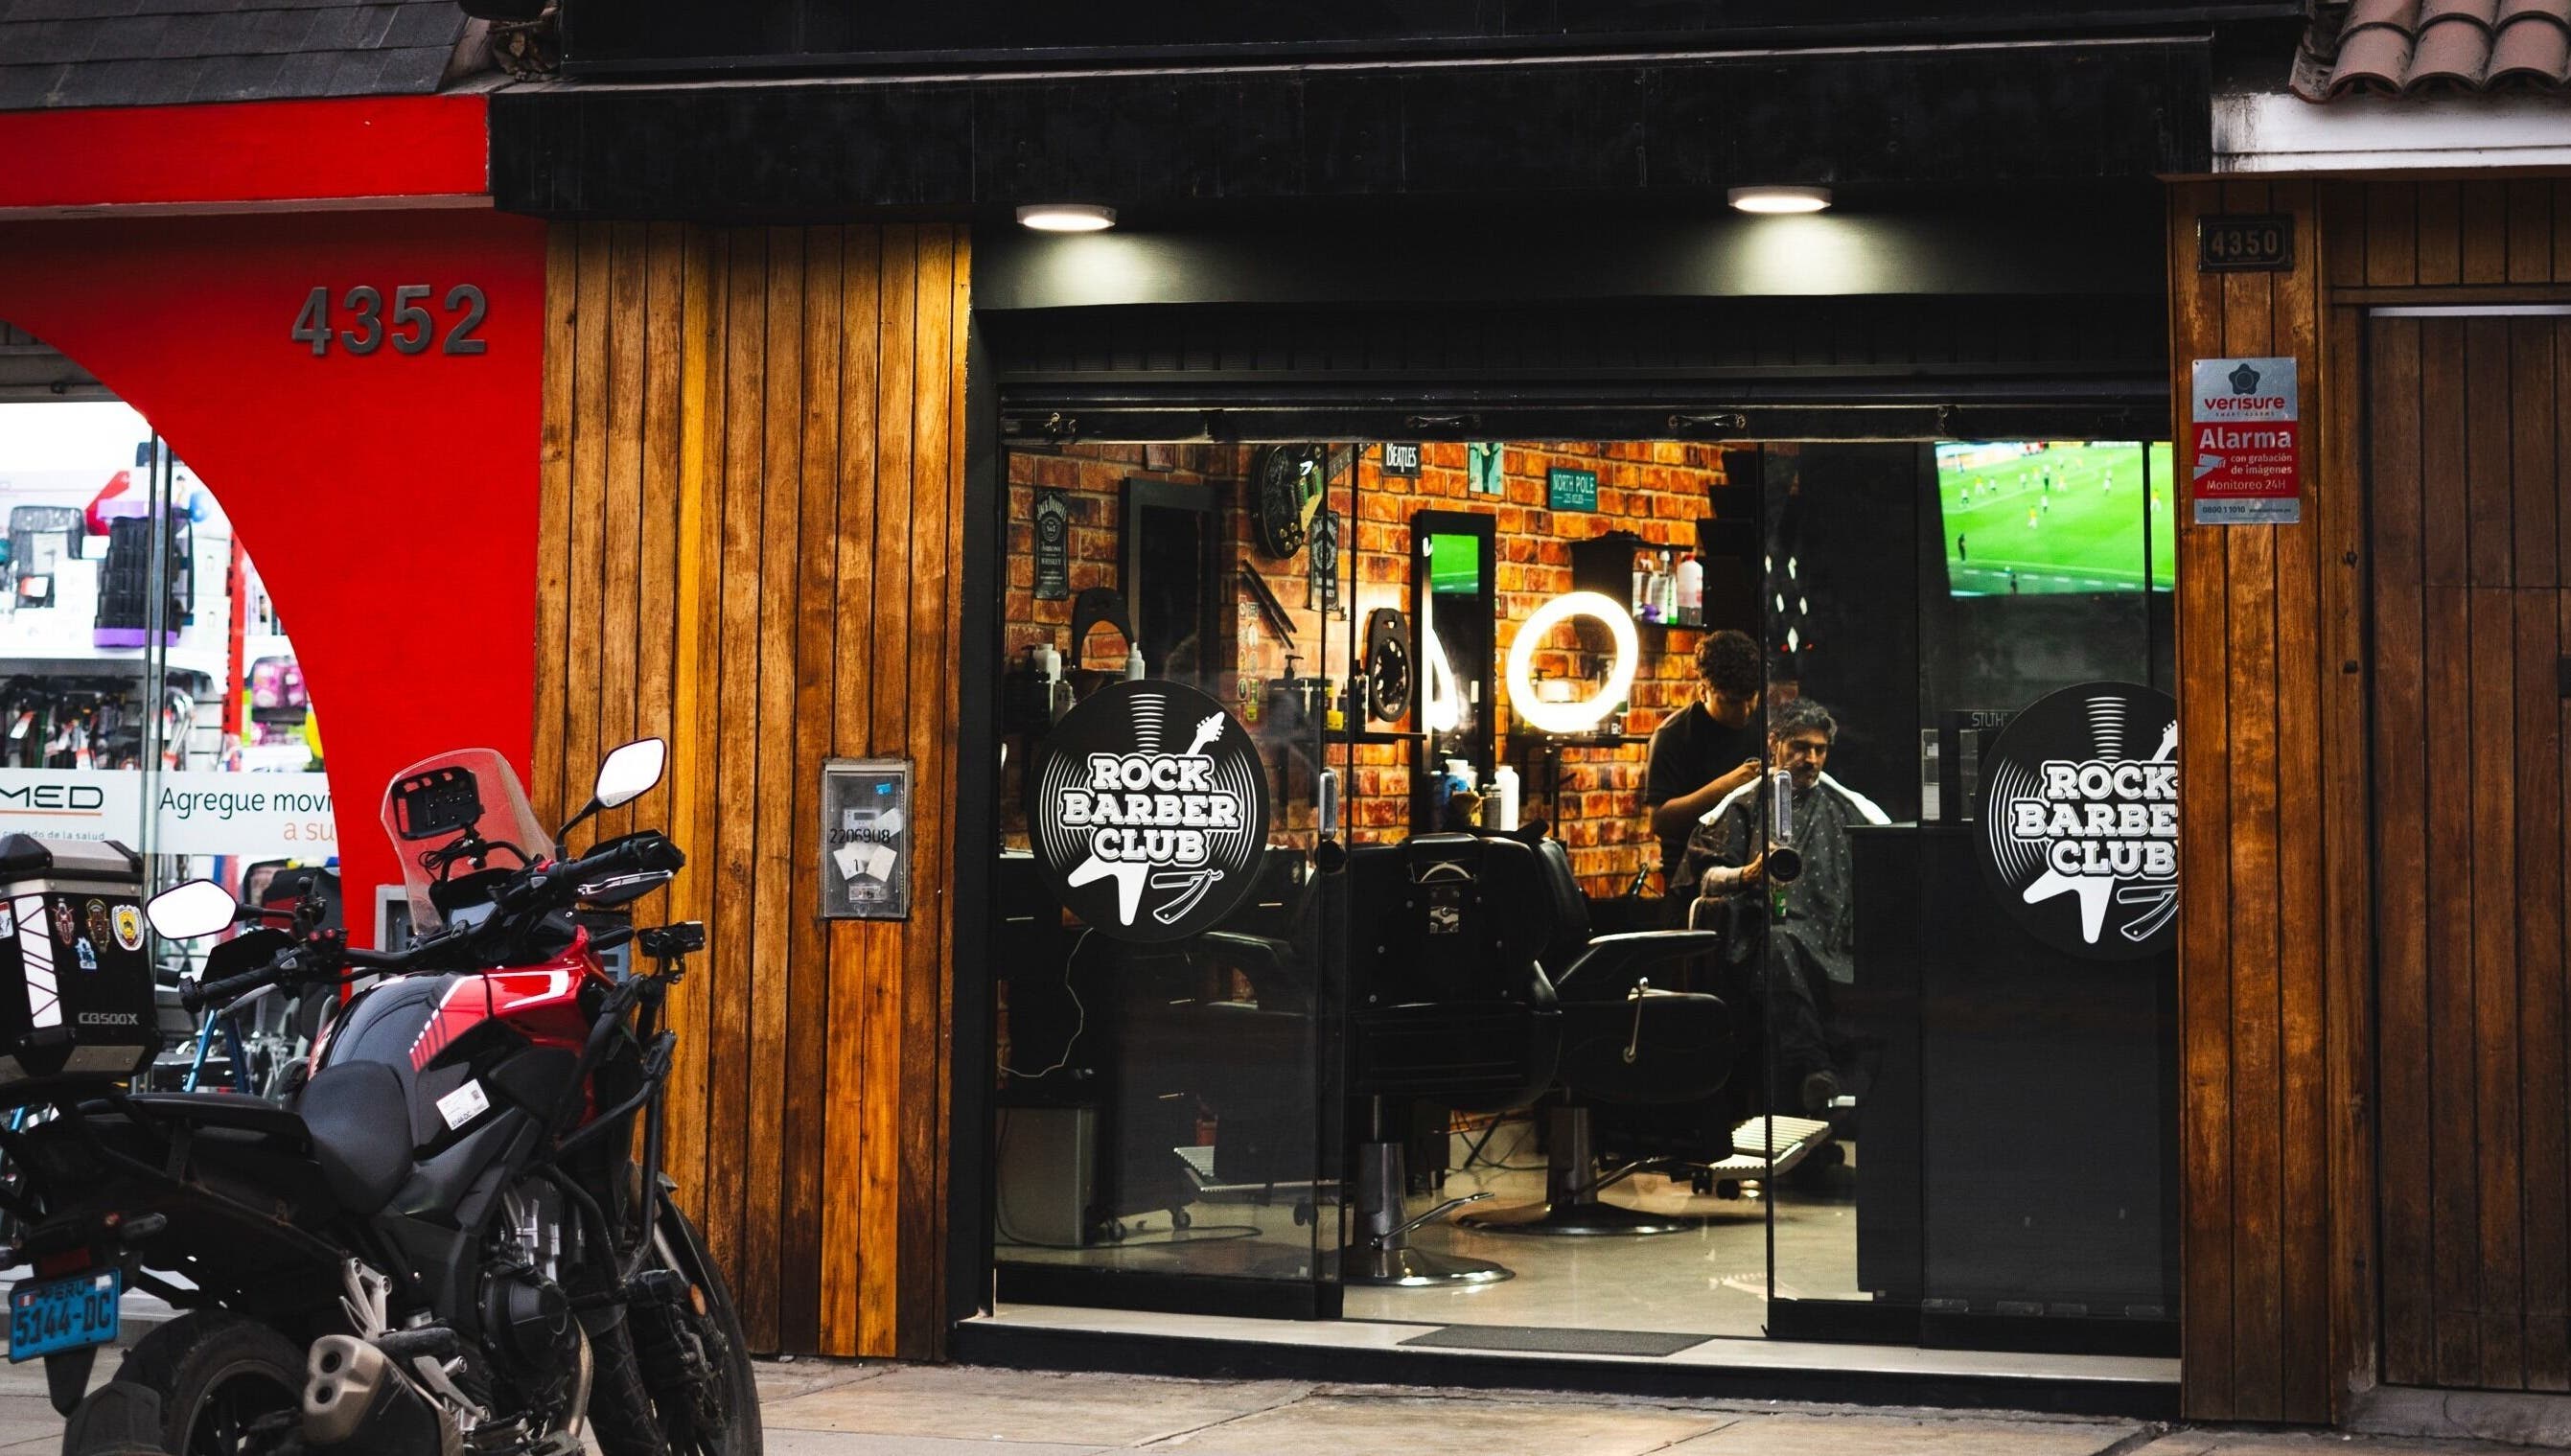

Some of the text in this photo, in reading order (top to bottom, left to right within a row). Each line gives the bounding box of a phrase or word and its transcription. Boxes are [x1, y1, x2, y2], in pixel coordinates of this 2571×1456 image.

[2212, 230, 2278, 257] 4350
[291, 284, 487, 356] 4352
[2205, 397, 2285, 410] verisure
[2199, 427, 2292, 450] Alarma
[1386, 443, 1417, 474] BEATLES
[2231, 465, 2293, 476] de imágenes
[2248, 453, 2293, 465] grabación
[1553, 474, 1595, 495] NORTH POLE
[2207, 479, 2286, 491] Monitoreo 24H
[2202, 505, 2222, 514] 0800
[1092, 757, 1211, 792] ROCK
[2046, 765, 2177, 800] ROCK
[0, 785, 104, 810] MED
[159, 787, 266, 820] Agregue
[1062, 793, 1239, 828] BARBER
[284, 821, 336, 842] a su
[2013, 802, 2177, 838] BARBE
[47, 830, 59, 839] de
[62, 830, 73, 840] la
[76, 831, 104, 841] salud
[1094, 827, 1206, 862] CLUB
[2050, 840, 2177, 874] CLUB
[79, 1012, 140, 1026] CB500X
[15, 1291, 112, 1348] 5144-DC
